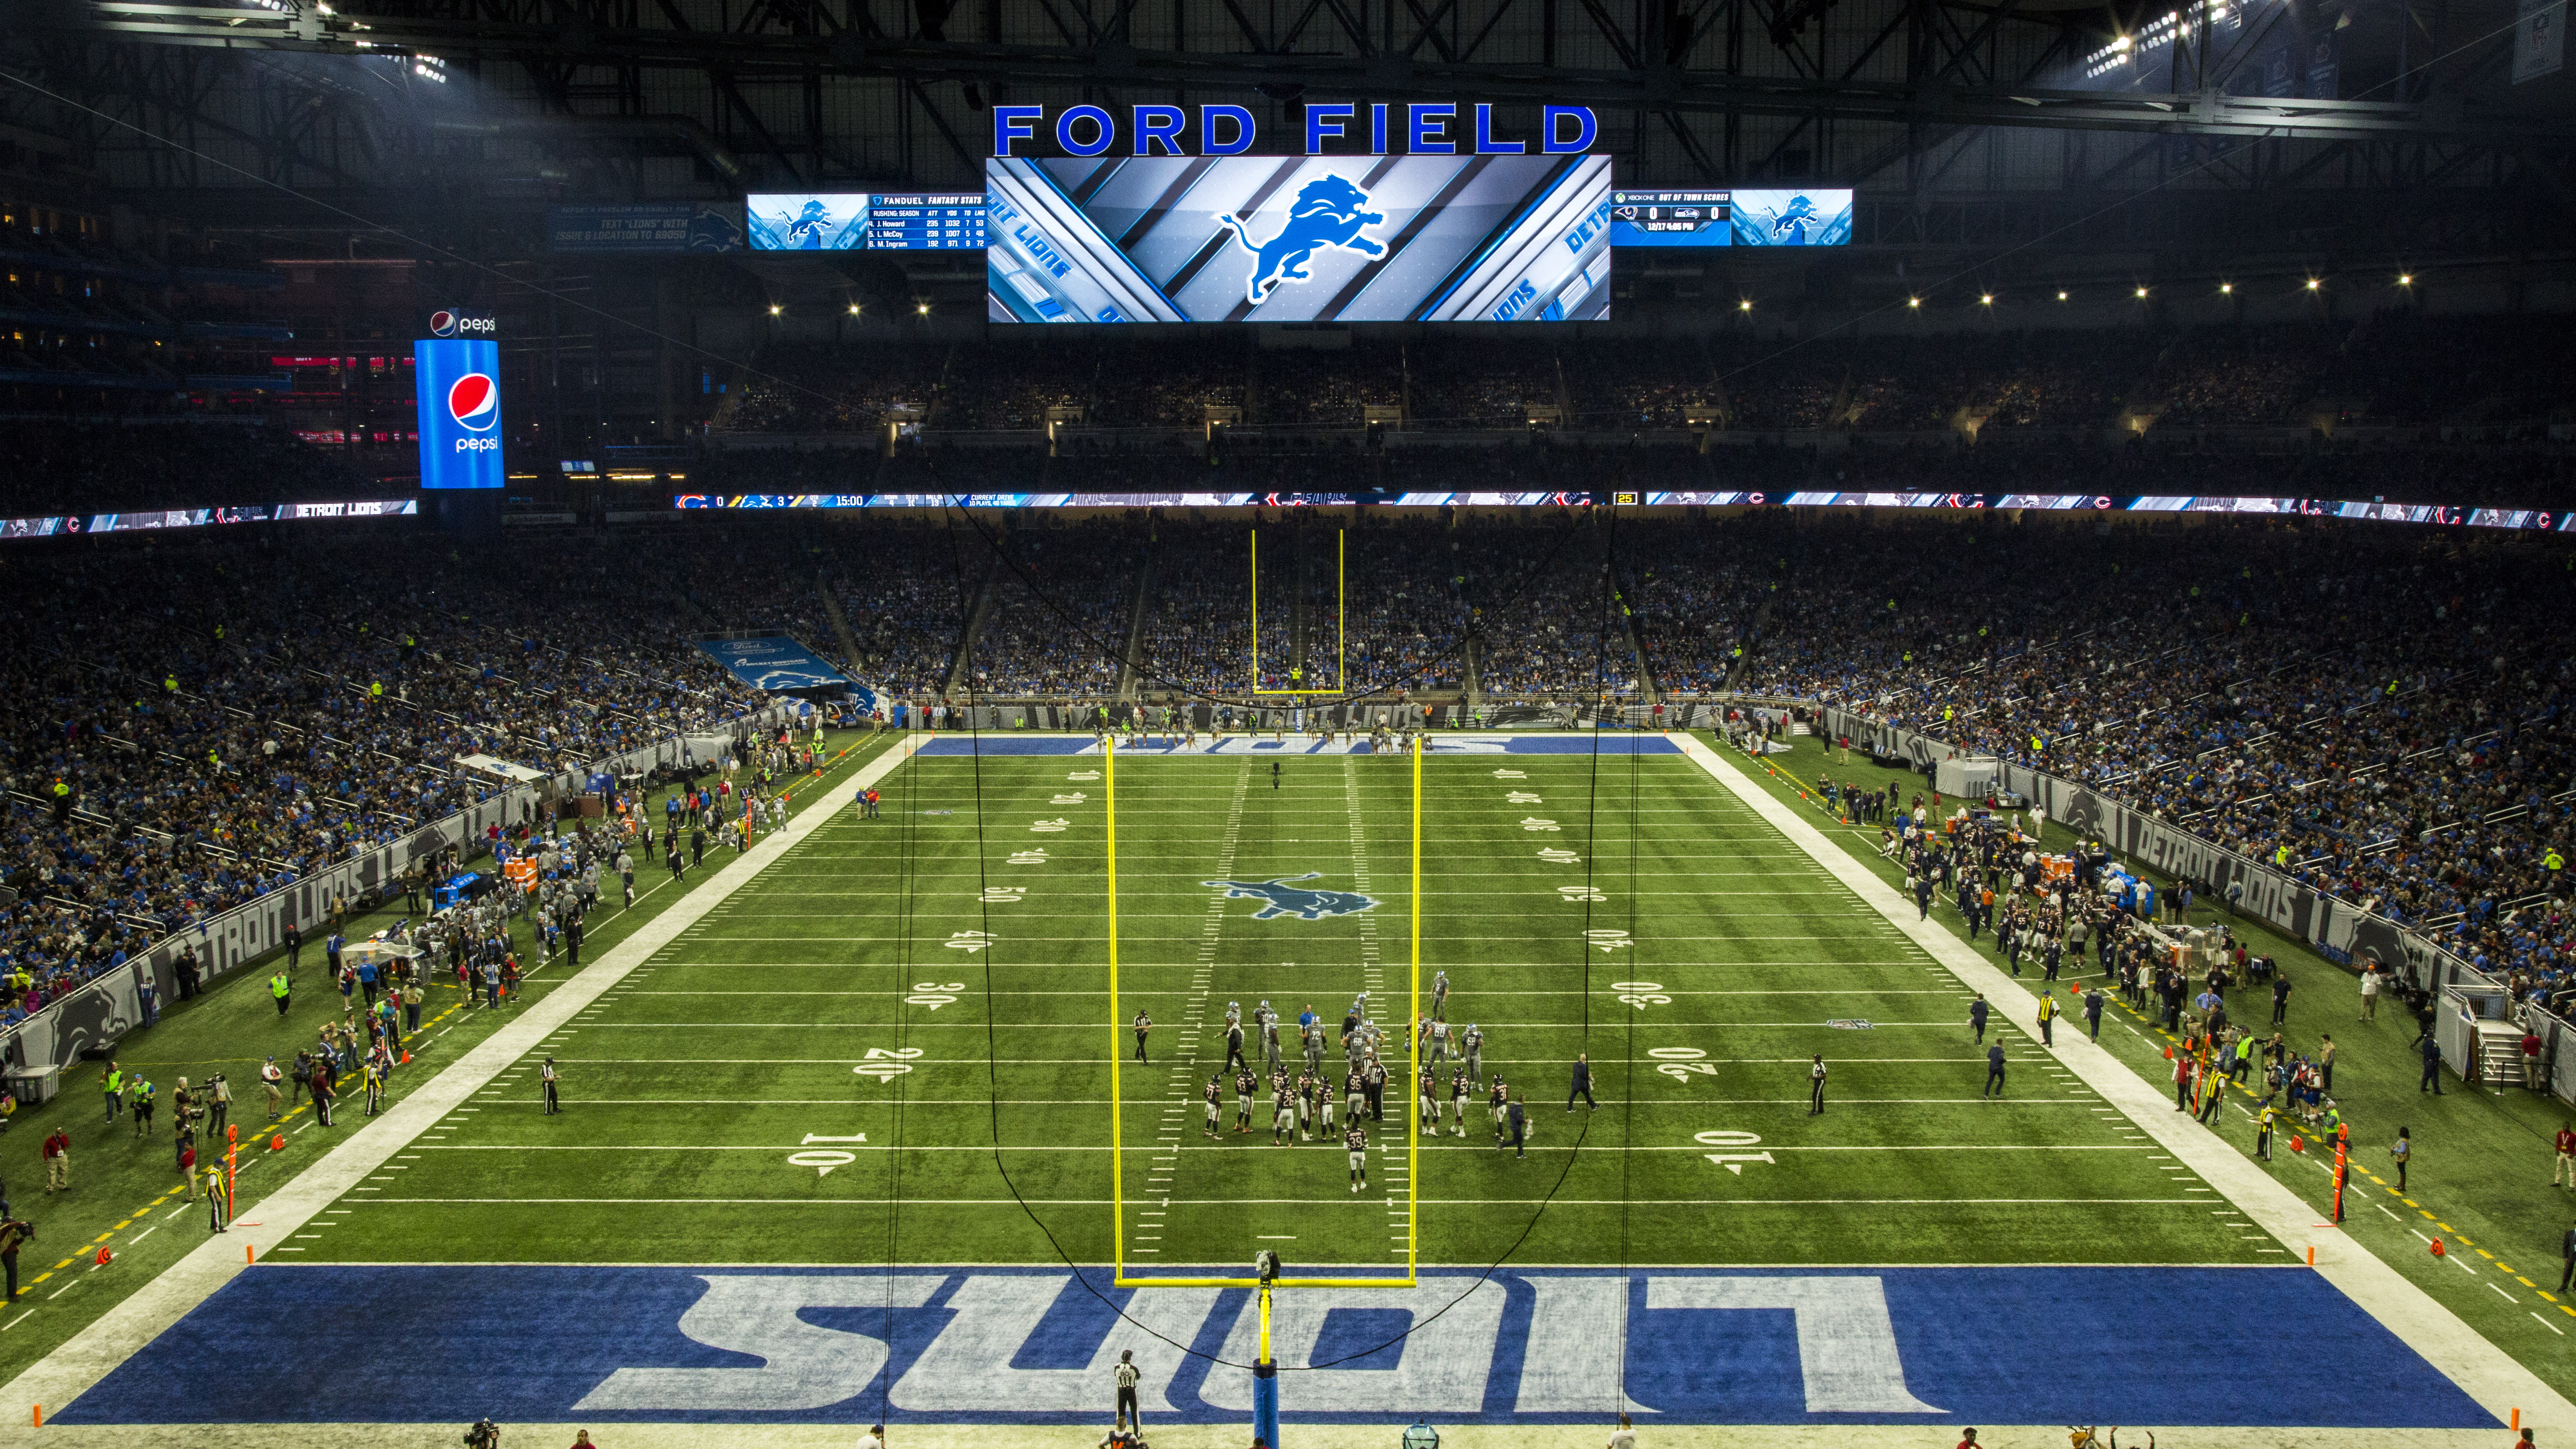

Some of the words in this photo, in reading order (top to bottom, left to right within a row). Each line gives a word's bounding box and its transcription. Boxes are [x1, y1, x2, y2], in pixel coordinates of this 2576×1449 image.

[993, 104, 1255, 156] FORD
[1305, 102, 1597, 155] FIELD
[928, 196, 959, 204] FANTASY
[960, 196, 982, 204] STATS
[1659, 193, 1672, 201] OUT
[1673, 193, 1681, 201] OF
[1683, 193, 1702, 201] TOWN
[1703, 193, 1729, 201] SCORES
[1649, 207, 1657, 220] 0
[1711, 207, 1718, 220] 0
[601, 219, 623, 229] TEXT
[662, 218, 688, 228] WITH
[1648, 222, 1665, 231] 12/17
[1666, 222, 1682, 231] 4:05
[1682, 222, 1694, 231] PM
[593, 230, 639, 240] LOCATION
[640, 230, 652, 240] TO
[883, 230, 903, 239] McCoy
[886, 241, 907, 249] Ingram
[1013, 222, 1074, 280] LIONS
[460, 318, 496, 334] pepsi
[455, 436, 498, 453] pepsi
[717, 496, 724, 506] 0
[778, 496, 784, 506] 3
[836, 496, 863, 506] 15:00
[1234, 496, 1243, 504] VS
[1527, 494, 1537, 503] VS
[1618, 494, 1632, 503] 25
[1921, 496, 1930, 504] VS
[2063, 498, 2072, 506] VS
[296, 503, 344, 517] DETROIT
[347, 502, 382, 516] LIONS
[1029, 819, 1071, 832] 30
[1520, 818, 1561, 832] 30
[1006, 850, 1050, 864] 40
[1536, 849, 1581, 864] 40
[2138, 817, 2224, 892] DETROIT
[2229, 854, 2298, 930] LIONS
[295, 861, 364, 933] LIONS
[978, 886, 1027, 902] 50
[1557, 886, 1607, 902] 50
[2038, 921, 2046, 929] 72
[944, 930, 998, 949] 40
[1581, 929, 1634, 948] 40
[903, 982, 966, 1005] 30
[1610, 981, 1672, 1005] 30
[1311, 1031, 1321, 1040] 72
[1434, 1027, 1445, 1038] 60
[852, 1047, 924, 1075] 20
[1647, 1046, 1719, 1075] 20
[1237, 1080, 1246, 1091] 93
[1350, 1078, 1361, 1090] 96
[1459, 1080, 1469, 1093] 52
[1283, 1095, 1295, 1106] 26
[1323, 1093, 1333, 1104] 53
[1500, 1088, 1507, 1100] 31
[276, 1135, 284, 1147] 10
[1349, 1137, 1363, 1148] 39
[1694, 1130, 1776, 1164] 10
[787, 1132, 868, 1166] 10
[2432, 1236, 2439, 1251] G
[102, 1247, 111, 1261] G
[571, 1273, 1951, 1413] LIONS
